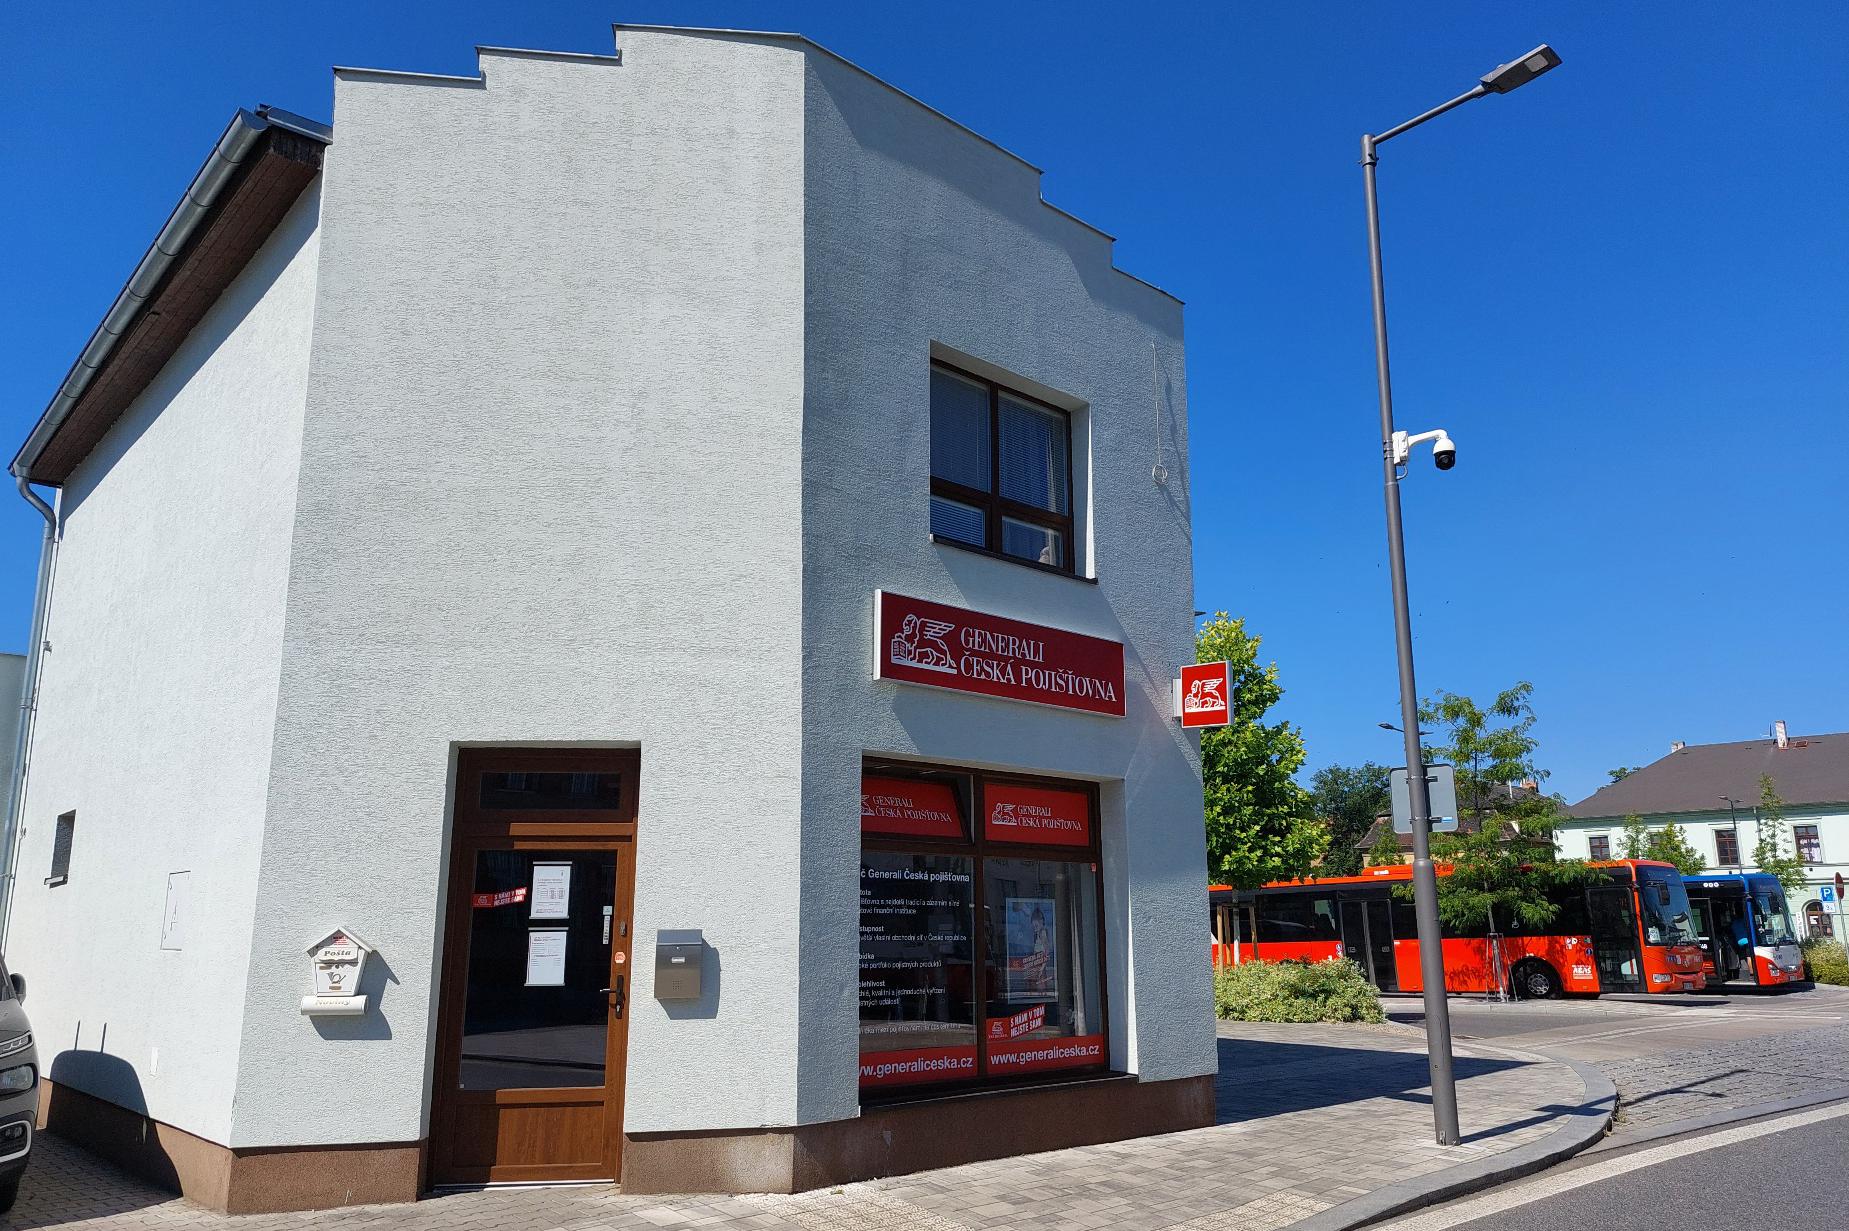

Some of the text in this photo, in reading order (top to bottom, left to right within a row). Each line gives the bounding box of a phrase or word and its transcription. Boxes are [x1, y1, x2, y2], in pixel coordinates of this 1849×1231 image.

[960, 626, 1045, 663] GENERALI
[960, 651, 1117, 702] ČESKÁ POJIŠŤOVNA
[872, 795, 913, 808] GENERALI
[1017, 804, 1051, 817] GENERALI
[868, 868, 902, 880] Generali
[904, 868, 929, 880] Česká
[930, 871, 970, 883] pojišťovna
[1823, 888, 1831, 898] P
[991, 1044, 1099, 1066] www.generaliceska.cz
